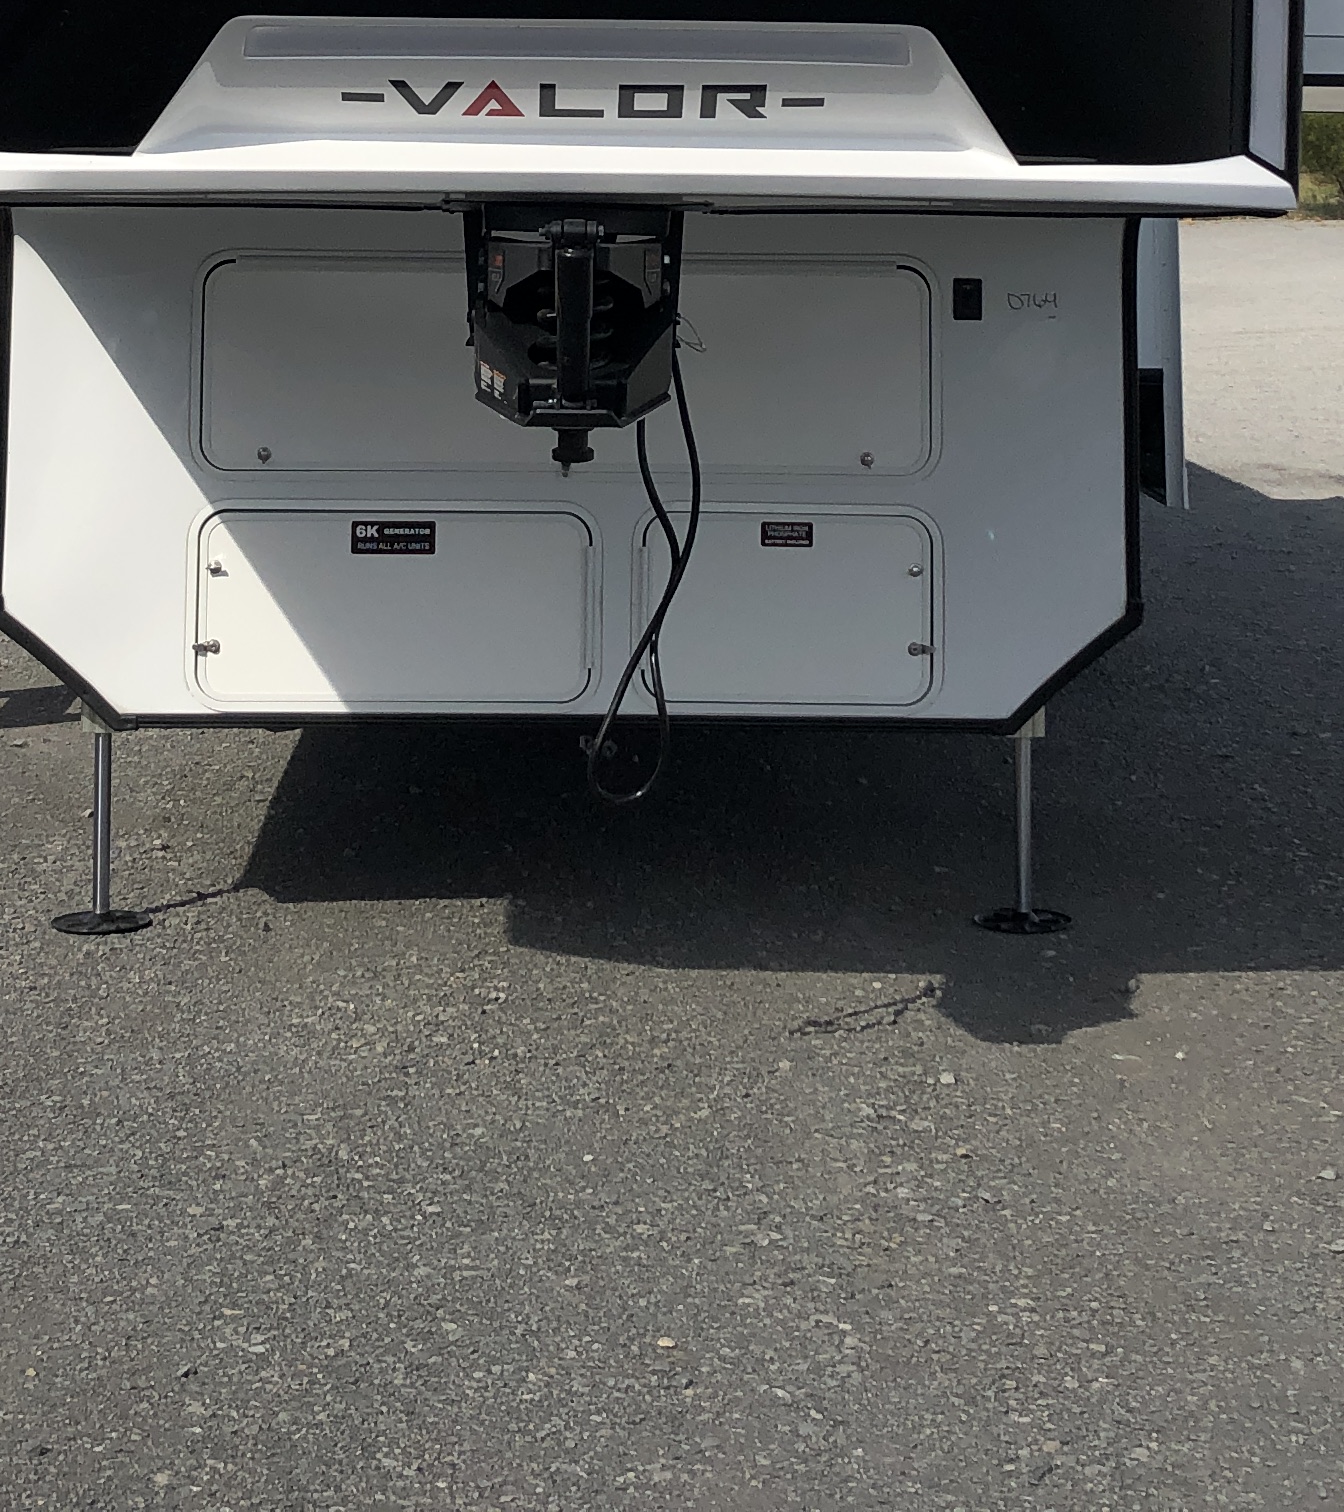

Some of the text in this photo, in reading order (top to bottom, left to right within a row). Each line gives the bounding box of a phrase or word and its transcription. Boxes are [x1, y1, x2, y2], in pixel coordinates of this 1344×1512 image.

[355, 524, 380, 538] 6K
[357, 541, 430, 550] RUNS ALL A/C UNITS
